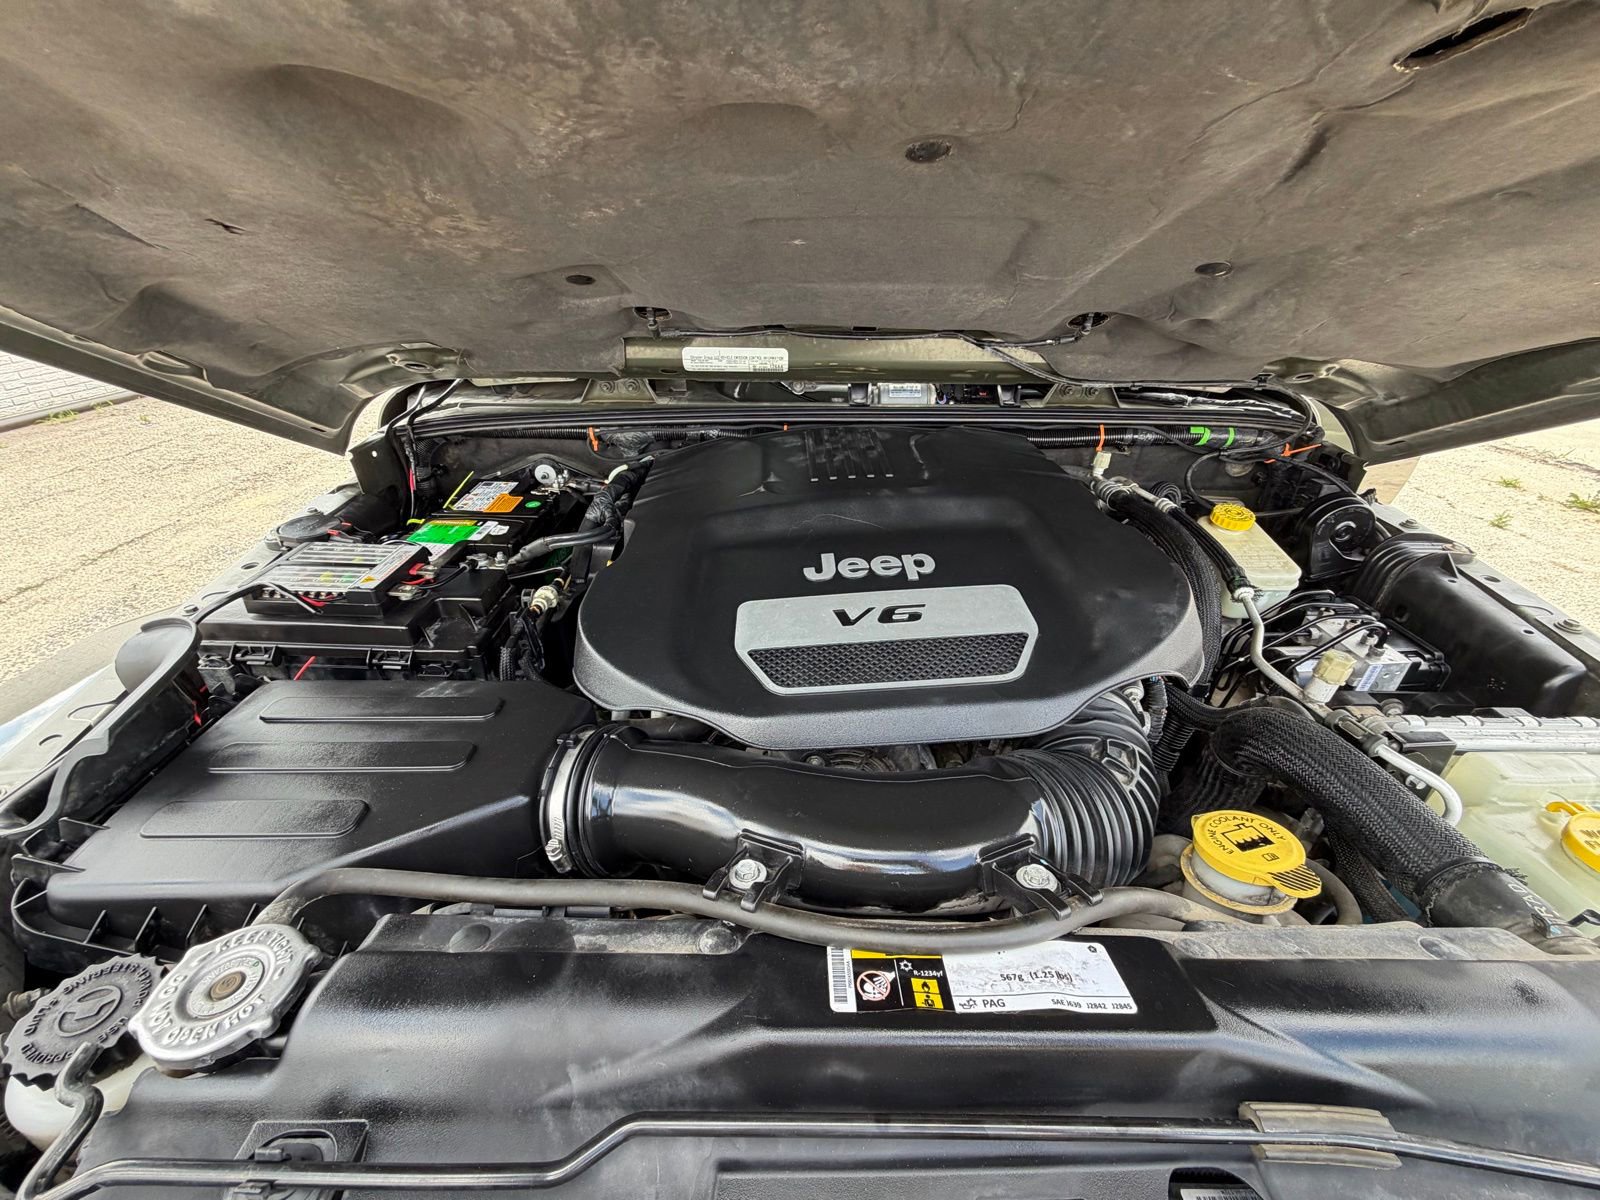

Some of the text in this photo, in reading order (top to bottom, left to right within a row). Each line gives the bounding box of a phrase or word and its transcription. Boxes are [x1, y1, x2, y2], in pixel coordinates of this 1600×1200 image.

[803, 553, 936, 582] Jeep
[832, 604, 926, 627] V6
[1207, 815, 1287, 855] ENGINE COOLANT ONLY
[215, 929, 295, 966] KEEP TIGHT
[62, 961, 141, 996] STEERING
[133, 966, 153, 1009] POWER
[158, 973, 189, 1000] DO
[912, 969, 944, 978] R-1234yf
[999, 970, 1074, 983] 567g (1.25 lbs)
[23, 997, 59, 1038] FLUID
[149, 1001, 174, 1035] NOT
[222, 993, 267, 1031] HOT
[982, 998, 1006, 1009] PAG
[1051, 998, 1065, 1006] SAE
[1086, 1001, 1108, 1010] J2842
[1111, 1002, 1133, 1011] J2845
[20, 1016, 129, 1064] USE PPROVED
[161, 1021, 220, 1046] OPEN
